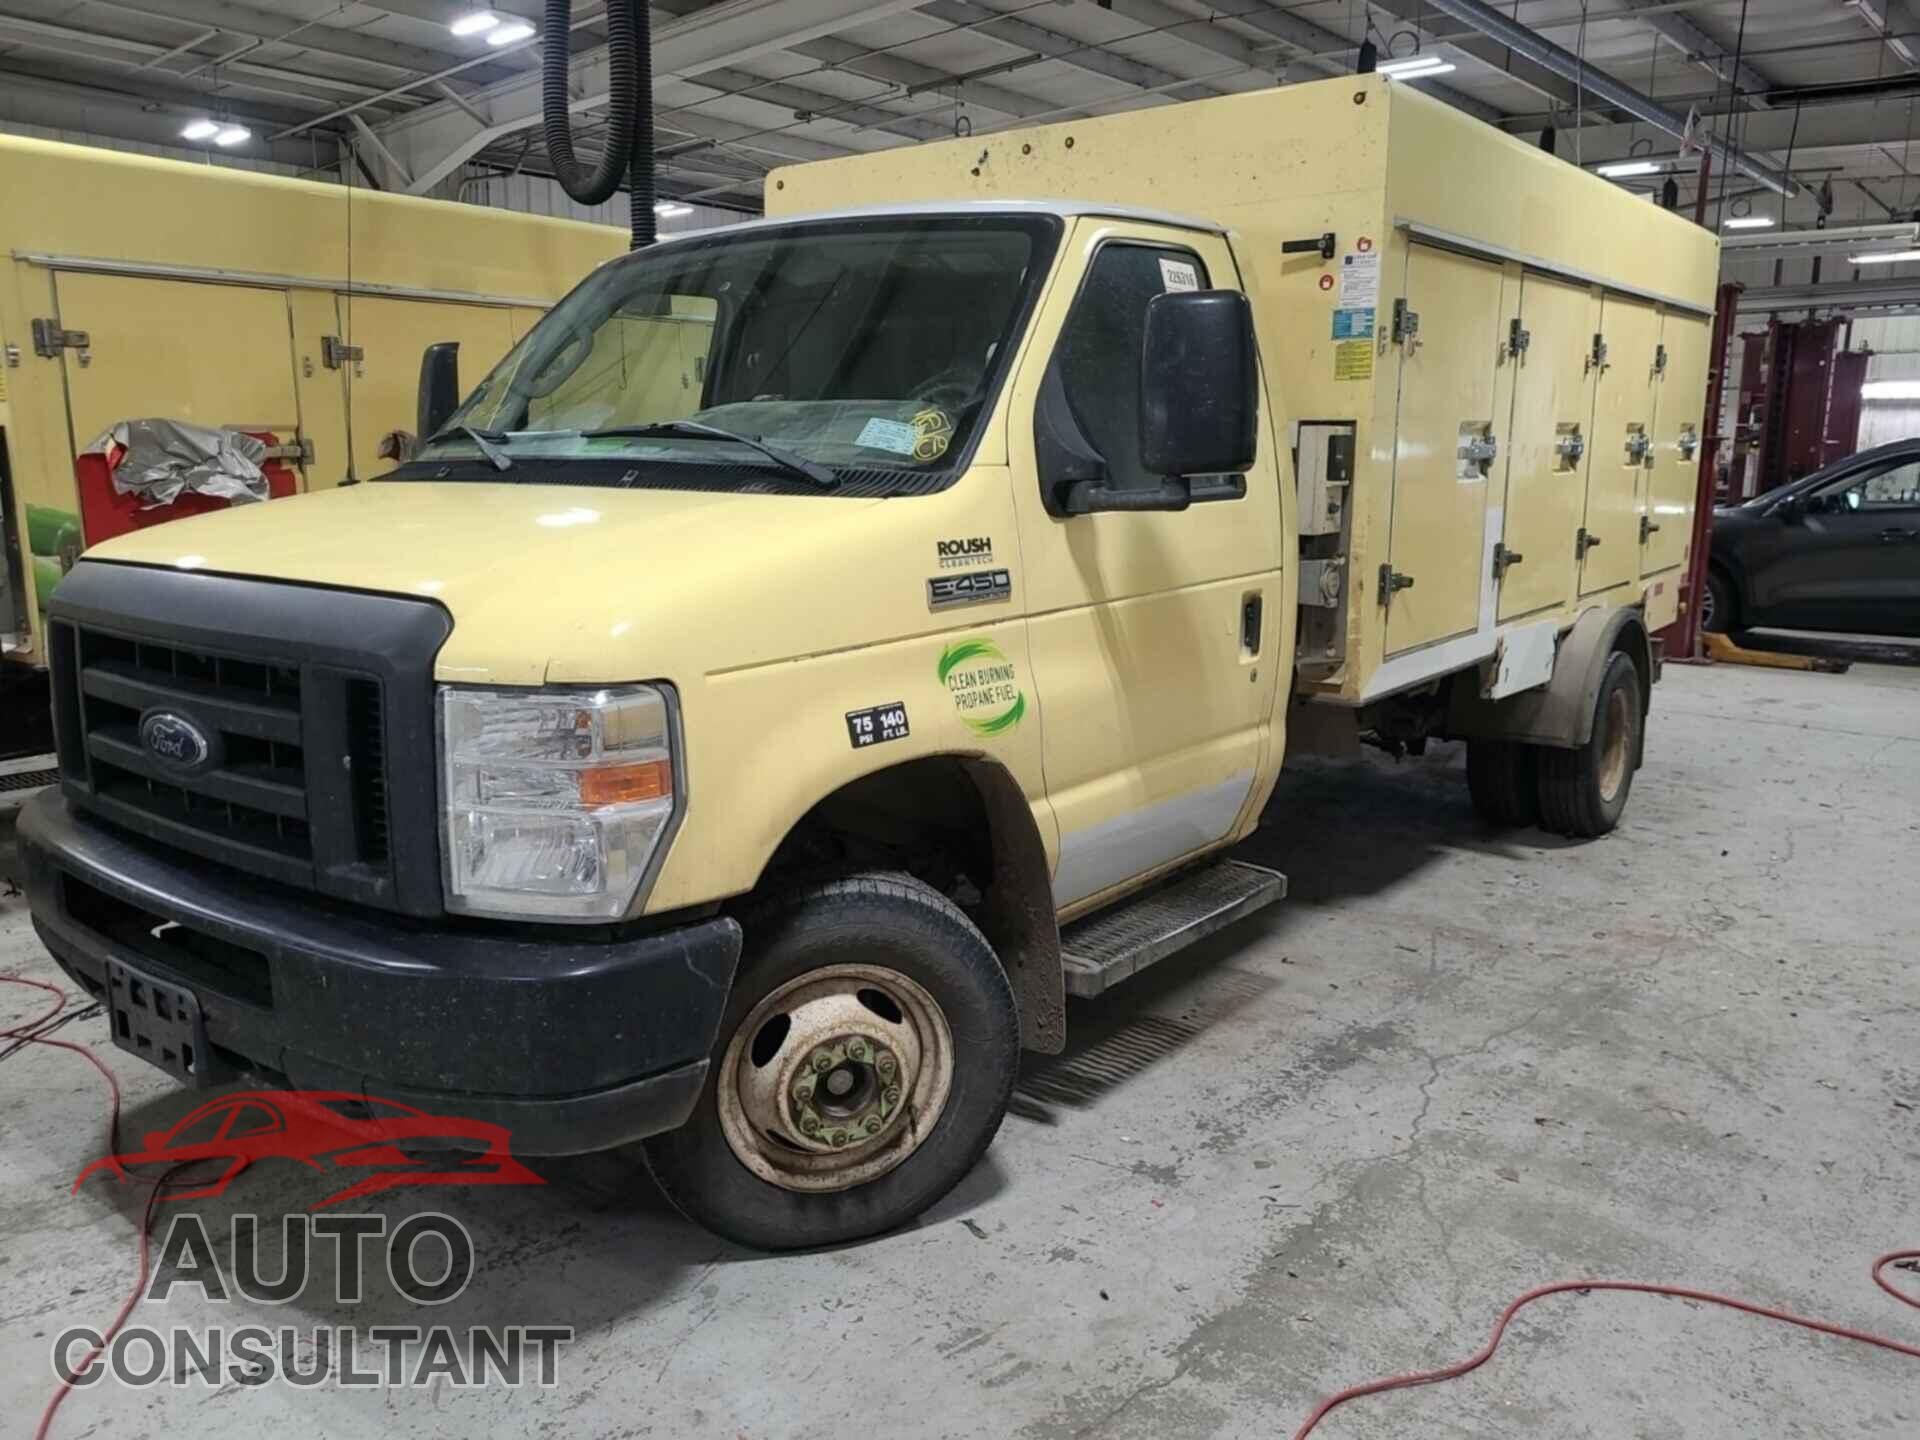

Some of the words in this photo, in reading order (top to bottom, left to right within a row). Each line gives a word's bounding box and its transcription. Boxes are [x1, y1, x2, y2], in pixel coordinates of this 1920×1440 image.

[937, 537, 992, 556] ROUSH
[948, 671, 977, 691] CLEAN
[977, 664, 1015, 685] BURNING
[955, 687, 995, 710] PROPANE
[995, 684, 1016, 701] FUEL
[852, 715, 873, 734] 75
[880, 710, 905, 728] 140
[151, 723, 185, 758] Ford
[859, 733, 874, 745] PSI
